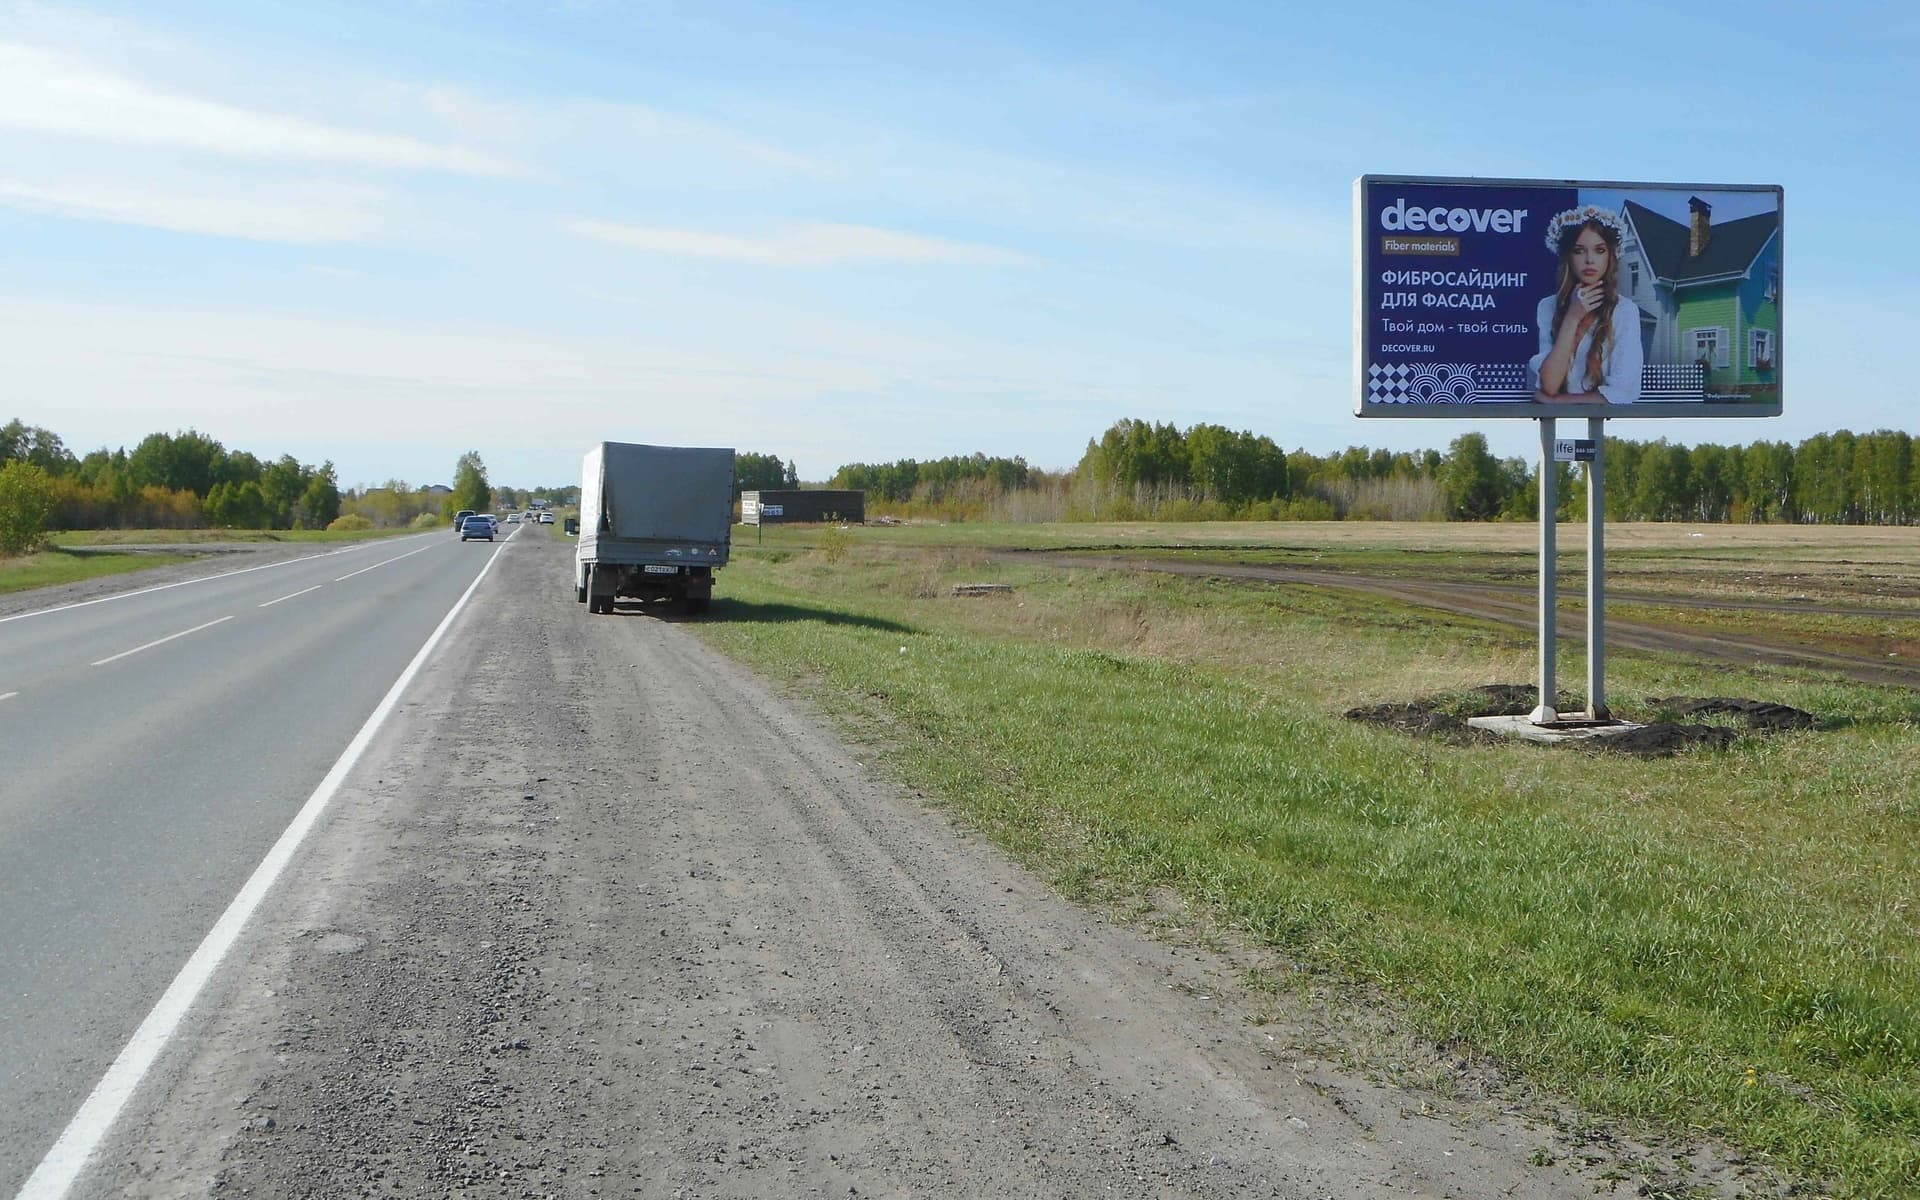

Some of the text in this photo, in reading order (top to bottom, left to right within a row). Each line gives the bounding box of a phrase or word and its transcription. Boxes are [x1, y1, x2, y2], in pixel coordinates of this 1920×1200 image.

[1381, 198, 1528, 233] decover
[1384, 239, 1410, 251] Fiber
[1381, 268, 1528, 290] ФИБРОСАЙДИНГ
[1381, 292, 1496, 310] ДЛЯ ФАСАДА
[1381, 318, 1414, 332] Твой
[1417, 323, 1445, 334] дом
[1457, 320, 1488, 334] твой
[1491, 323, 1529, 334] стиль
[1381, 344, 1435, 353] DECOVER.RU
